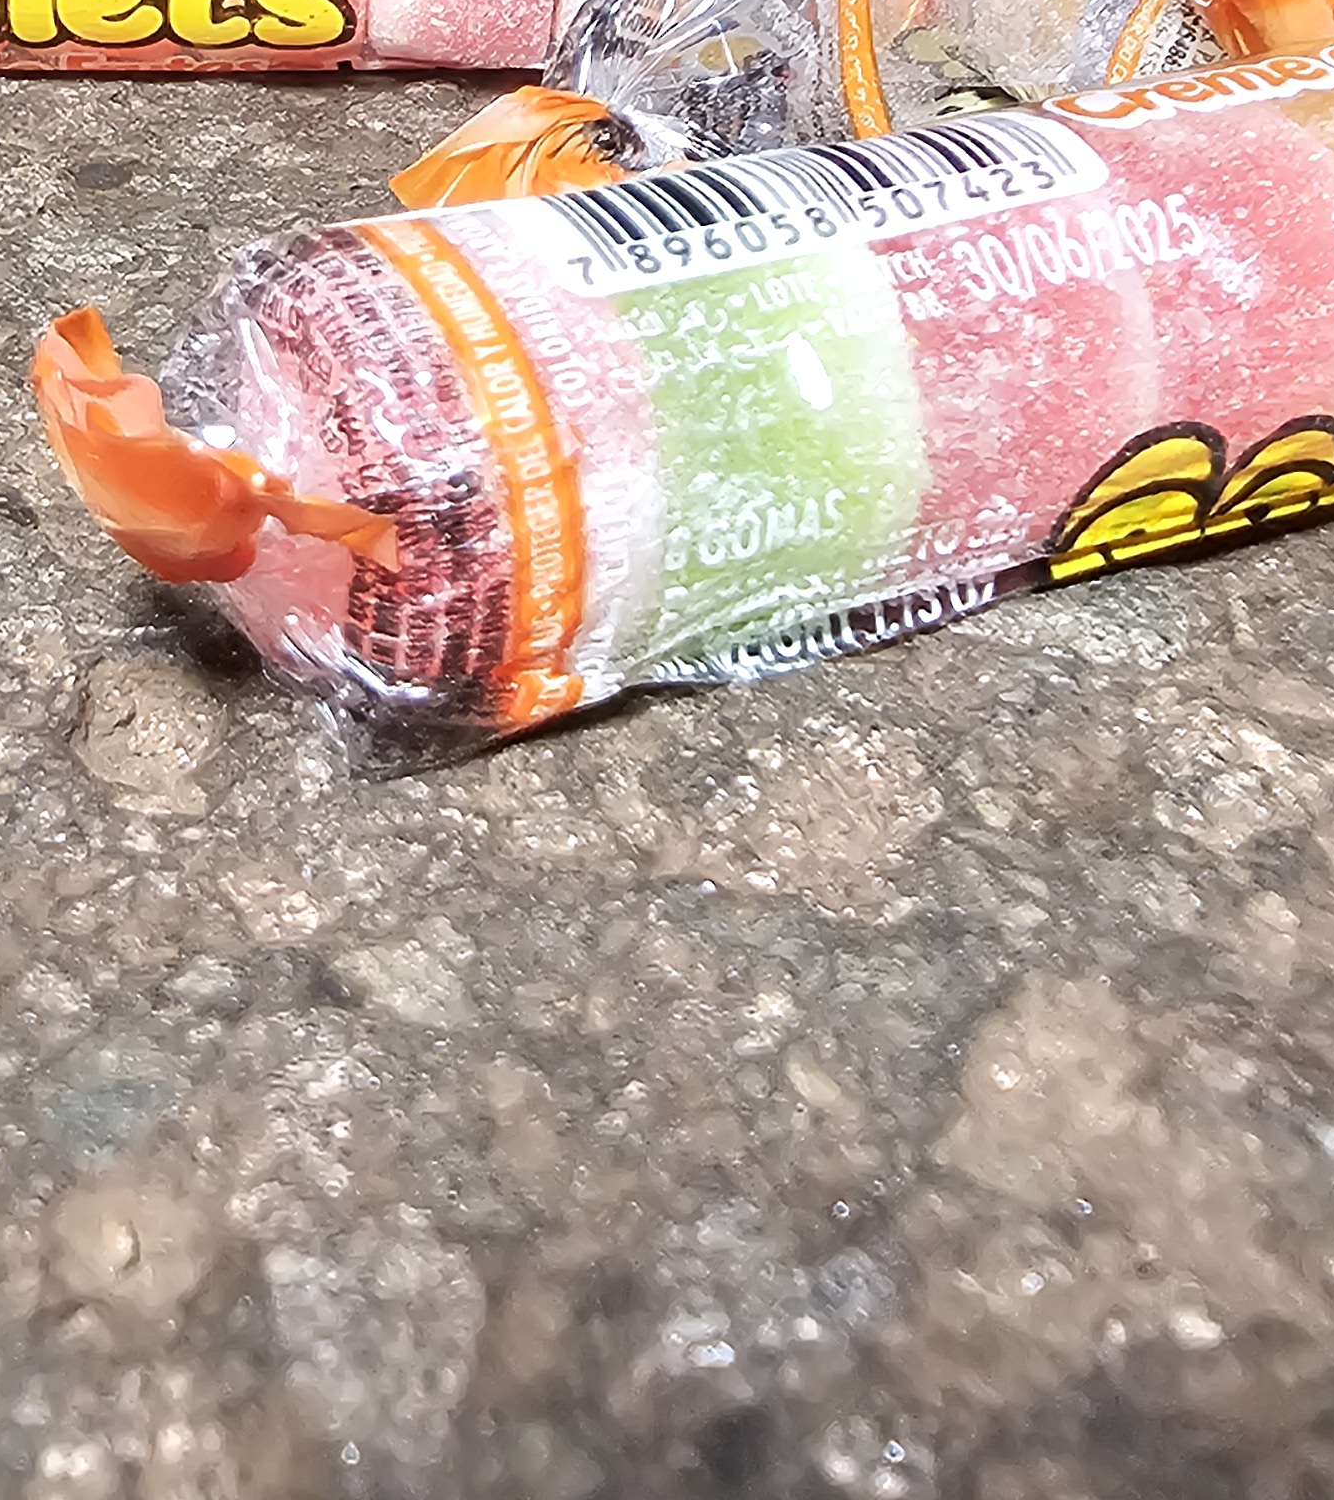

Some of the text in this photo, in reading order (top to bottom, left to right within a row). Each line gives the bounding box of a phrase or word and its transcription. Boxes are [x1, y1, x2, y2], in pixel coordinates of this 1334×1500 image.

[1051, 54, 1323, 122] Creme
[567, 160, 1057, 286] 7 896058 507423
[484, 358, 538, 435] CALOR
